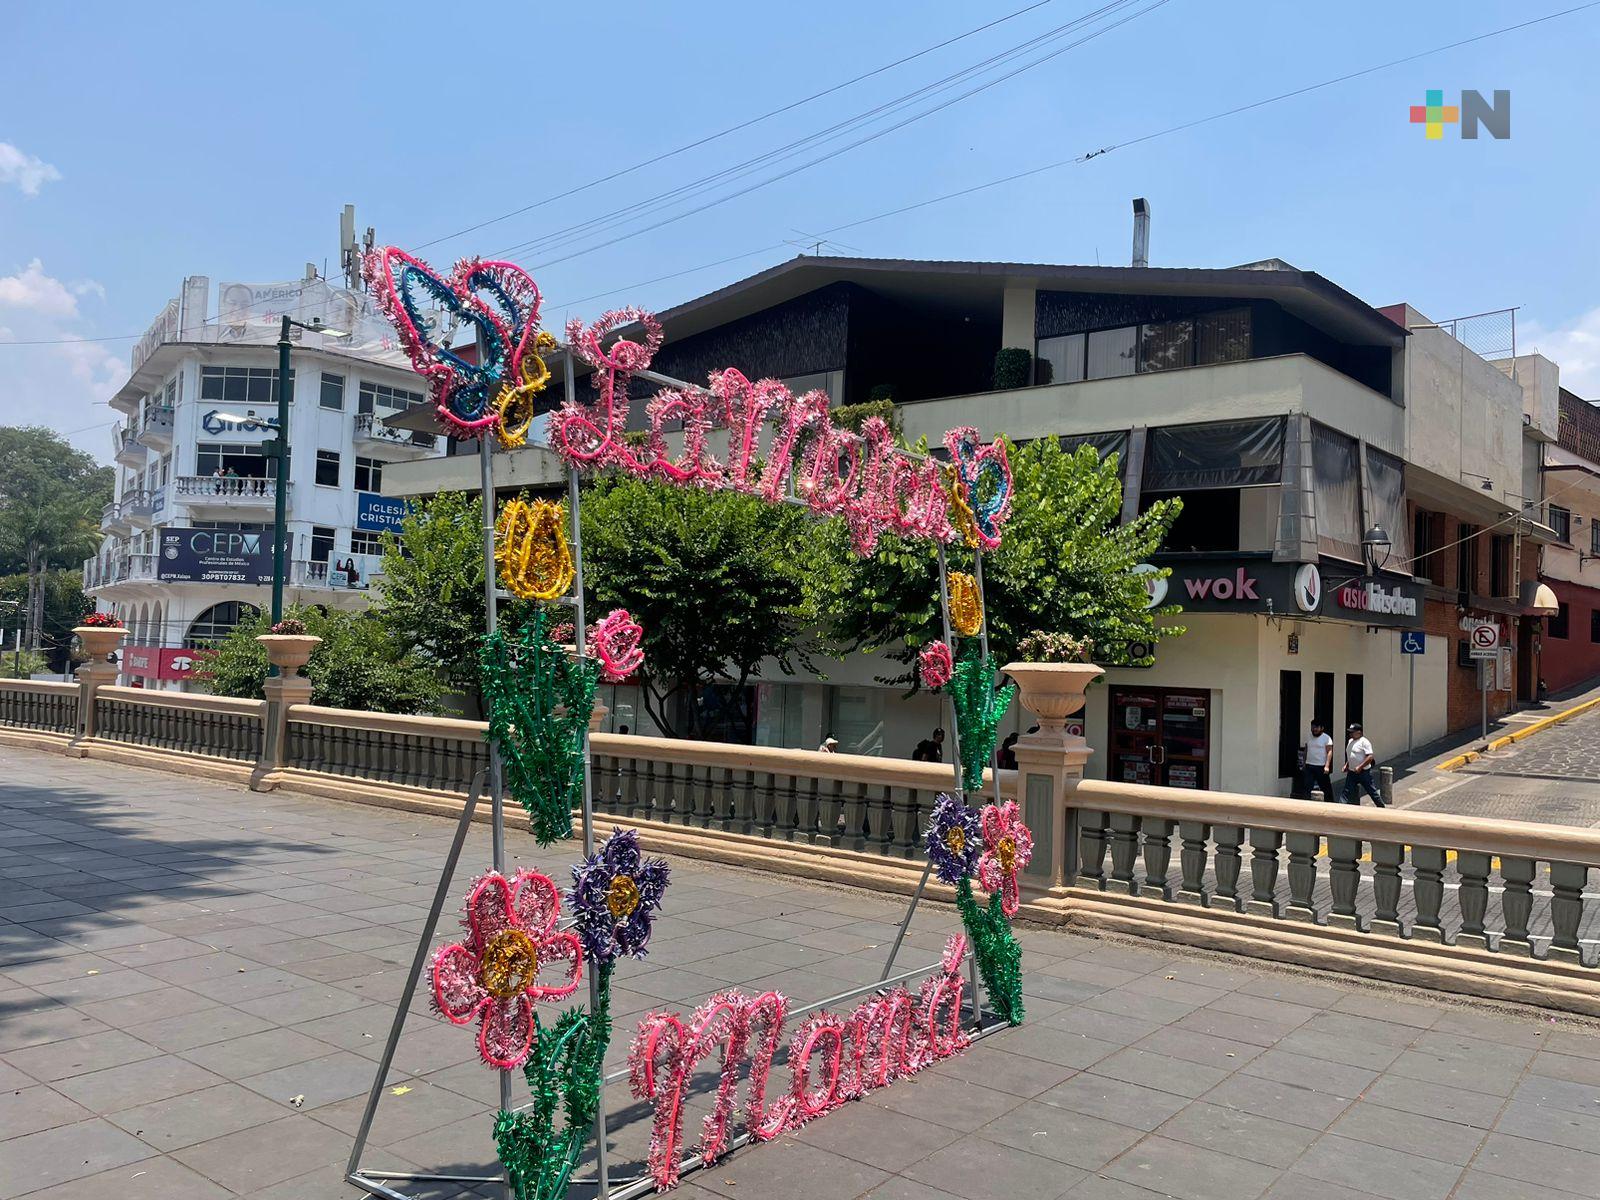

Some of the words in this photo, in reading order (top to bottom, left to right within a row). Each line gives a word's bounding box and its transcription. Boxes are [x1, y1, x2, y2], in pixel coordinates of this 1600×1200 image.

[360, 512, 402, 525] CRISTIA
[191, 531, 260, 554] CEPM
[1183, 567, 1260, 600] wok
